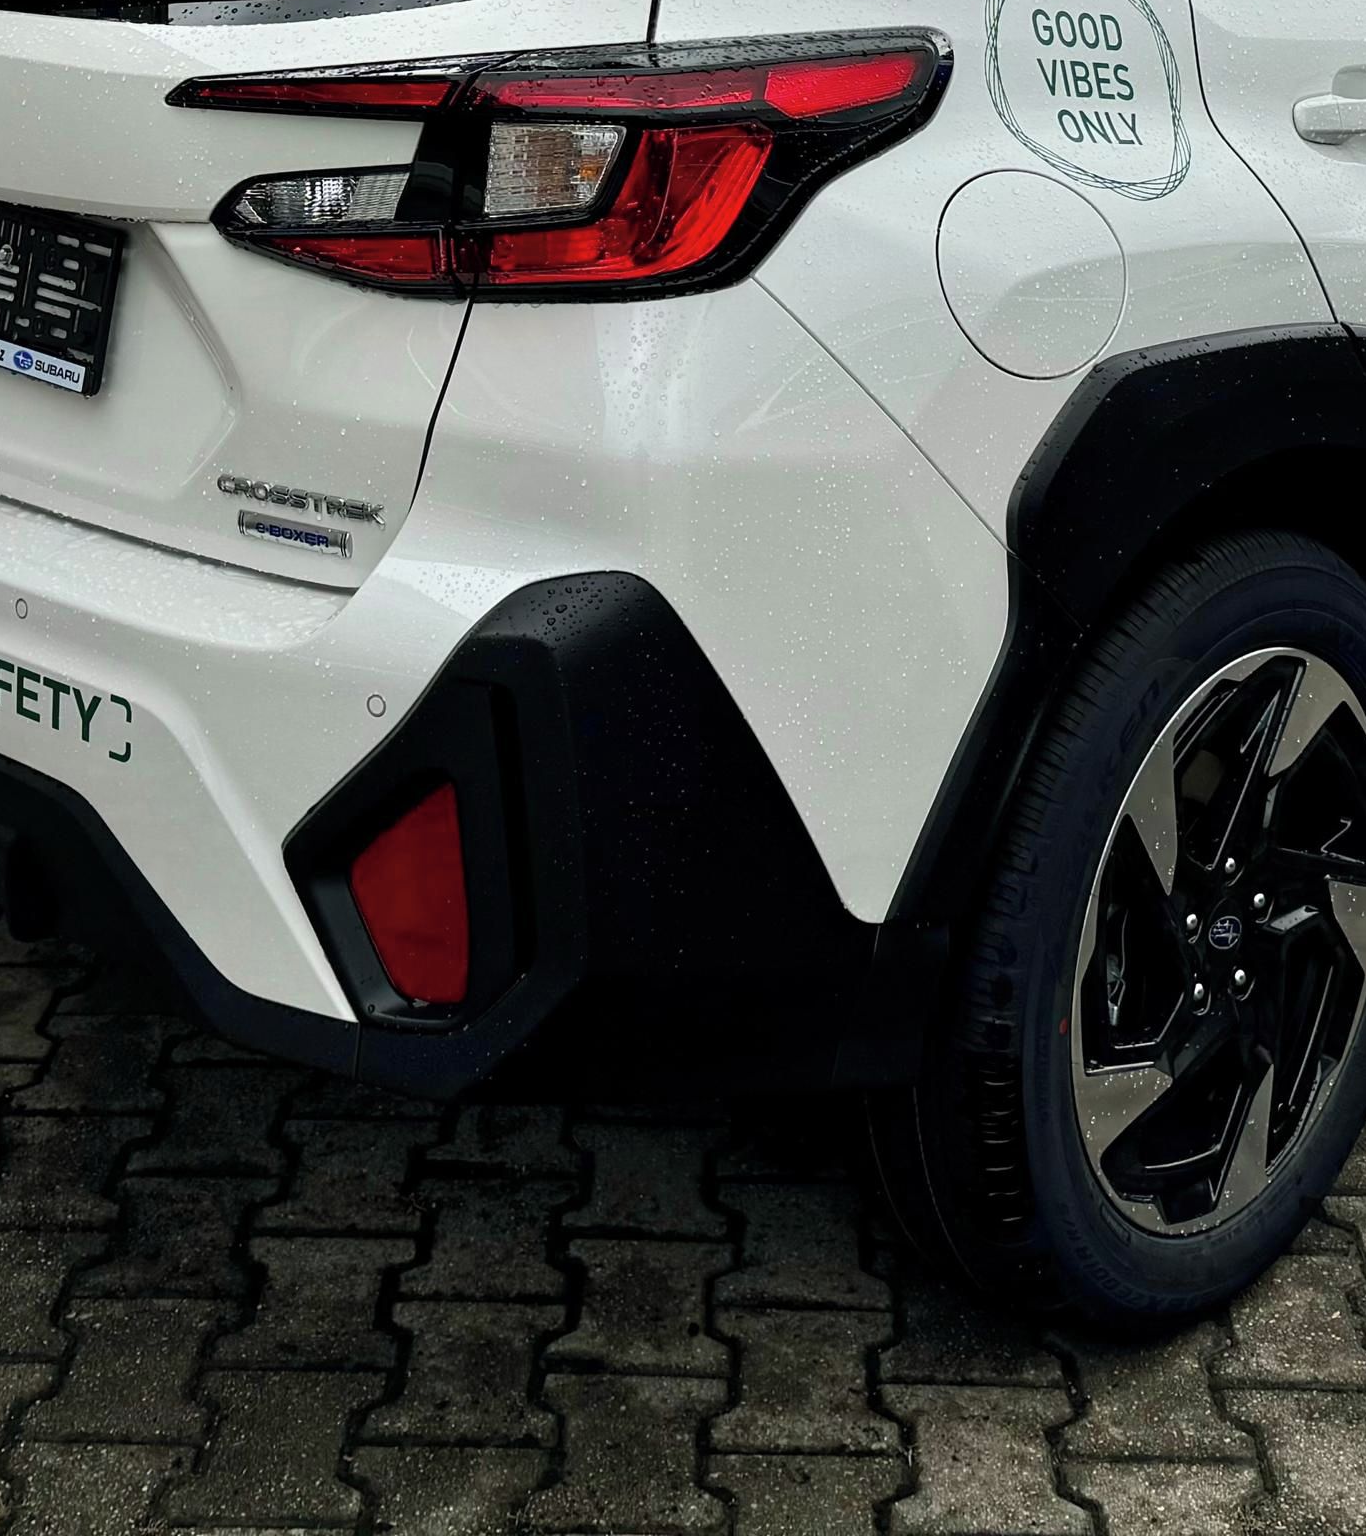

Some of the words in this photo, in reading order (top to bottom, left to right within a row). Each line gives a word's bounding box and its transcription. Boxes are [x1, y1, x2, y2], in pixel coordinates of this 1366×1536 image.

[1031, 8, 1123, 52] GOOD
[1036, 57, 1135, 101] VIBES
[1057, 109, 1143, 146] ONLY
[34, 359, 81, 384] SUBARU
[217, 473, 386, 527] CROSSTREK
